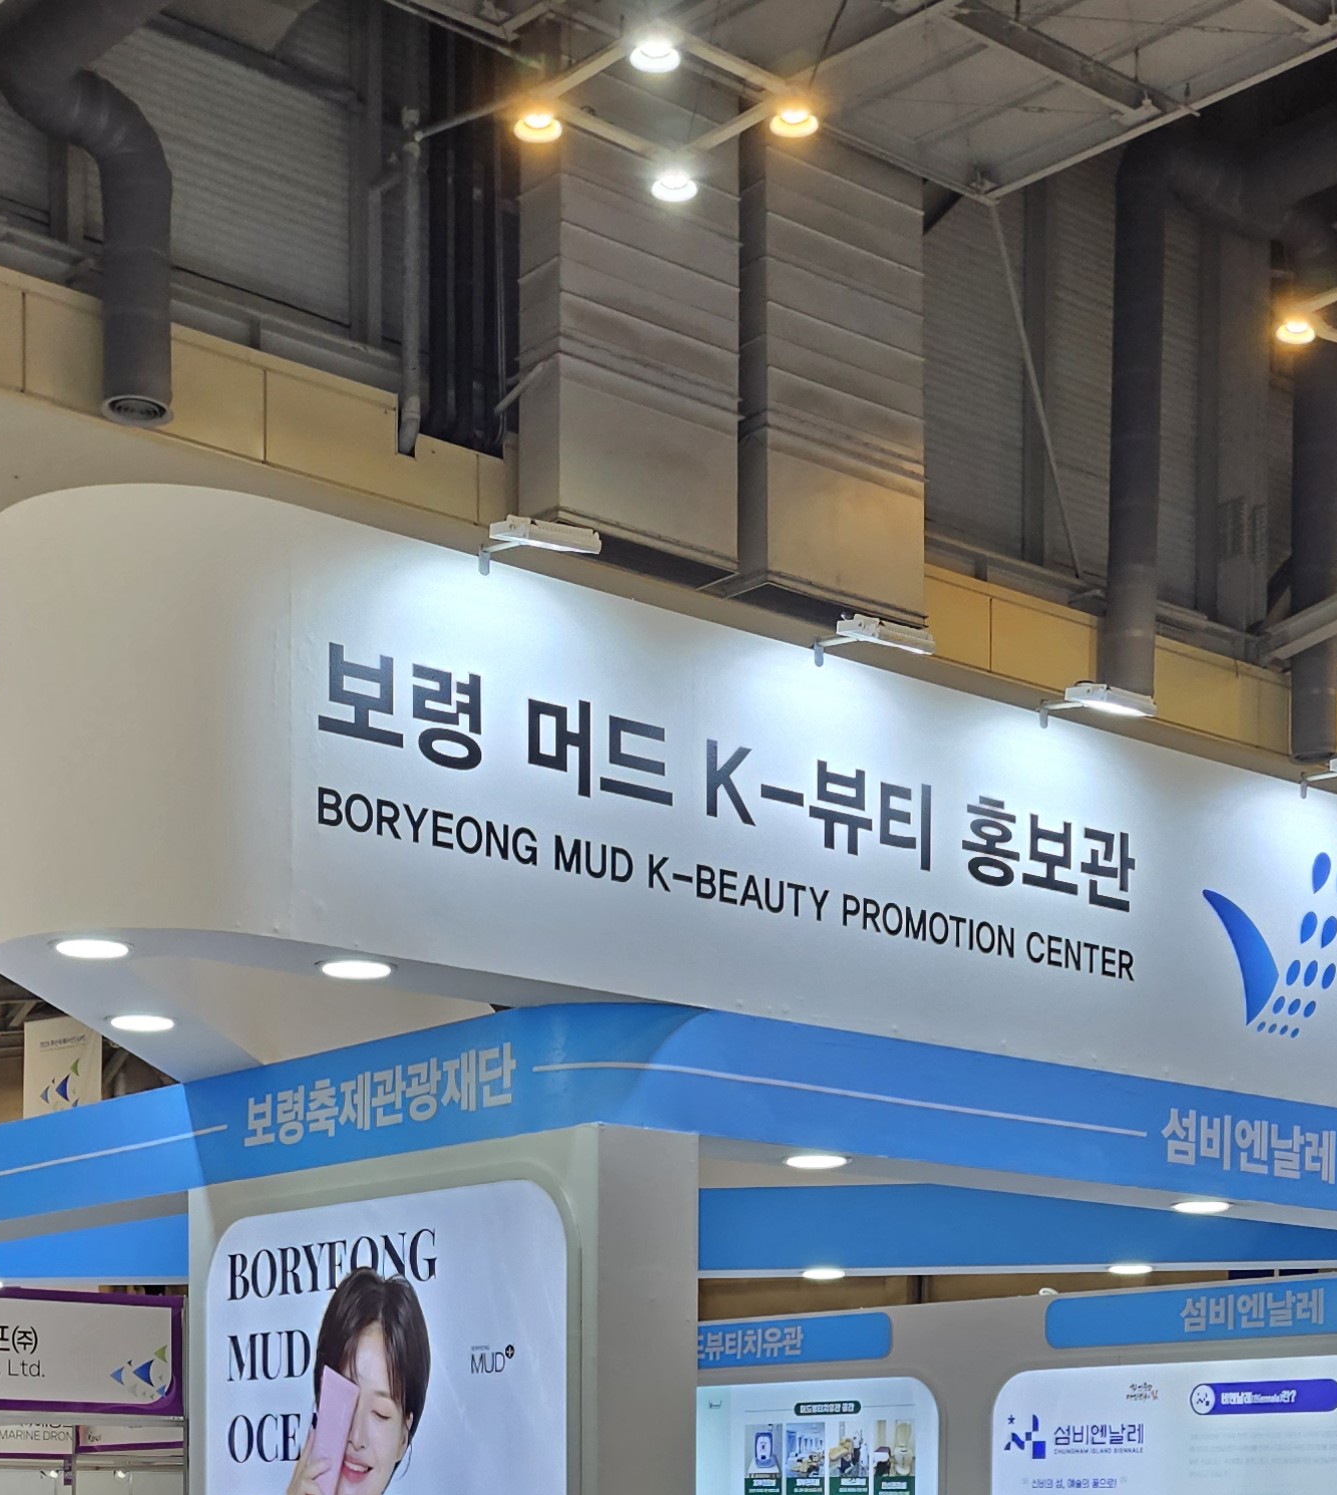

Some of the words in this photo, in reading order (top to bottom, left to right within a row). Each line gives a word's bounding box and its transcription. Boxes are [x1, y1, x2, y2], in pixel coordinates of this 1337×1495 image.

[318, 641, 483, 771] 보령
[527, 697, 674, 808] 머드
[705, 737, 932, 872] K-뷰티
[961, 795, 1137, 913] 홍보관
[317, 786, 538, 867] BORYEONG
[554, 835, 634, 884] MUD
[647, 854, 830, 921] K-BEAUTY
[842, 893, 1016, 959] PROMOTION
[1025, 931, 1135, 982] CENTER
[244, 1042, 516, 1147] 보령축제관광재단
[1161, 1107, 1337, 1185] 섬비엔날레
[1180, 1287, 1325, 1333] 섬비엔날레
[7, 1359, 46, 1378] Ltd.
[227, 1329, 311, 1382] MUD
[471, 1351, 505, 1374] MUD
[228, 1412, 318, 1463] OCE
[1054, 1423, 1144, 1446] 섬비엔날레
